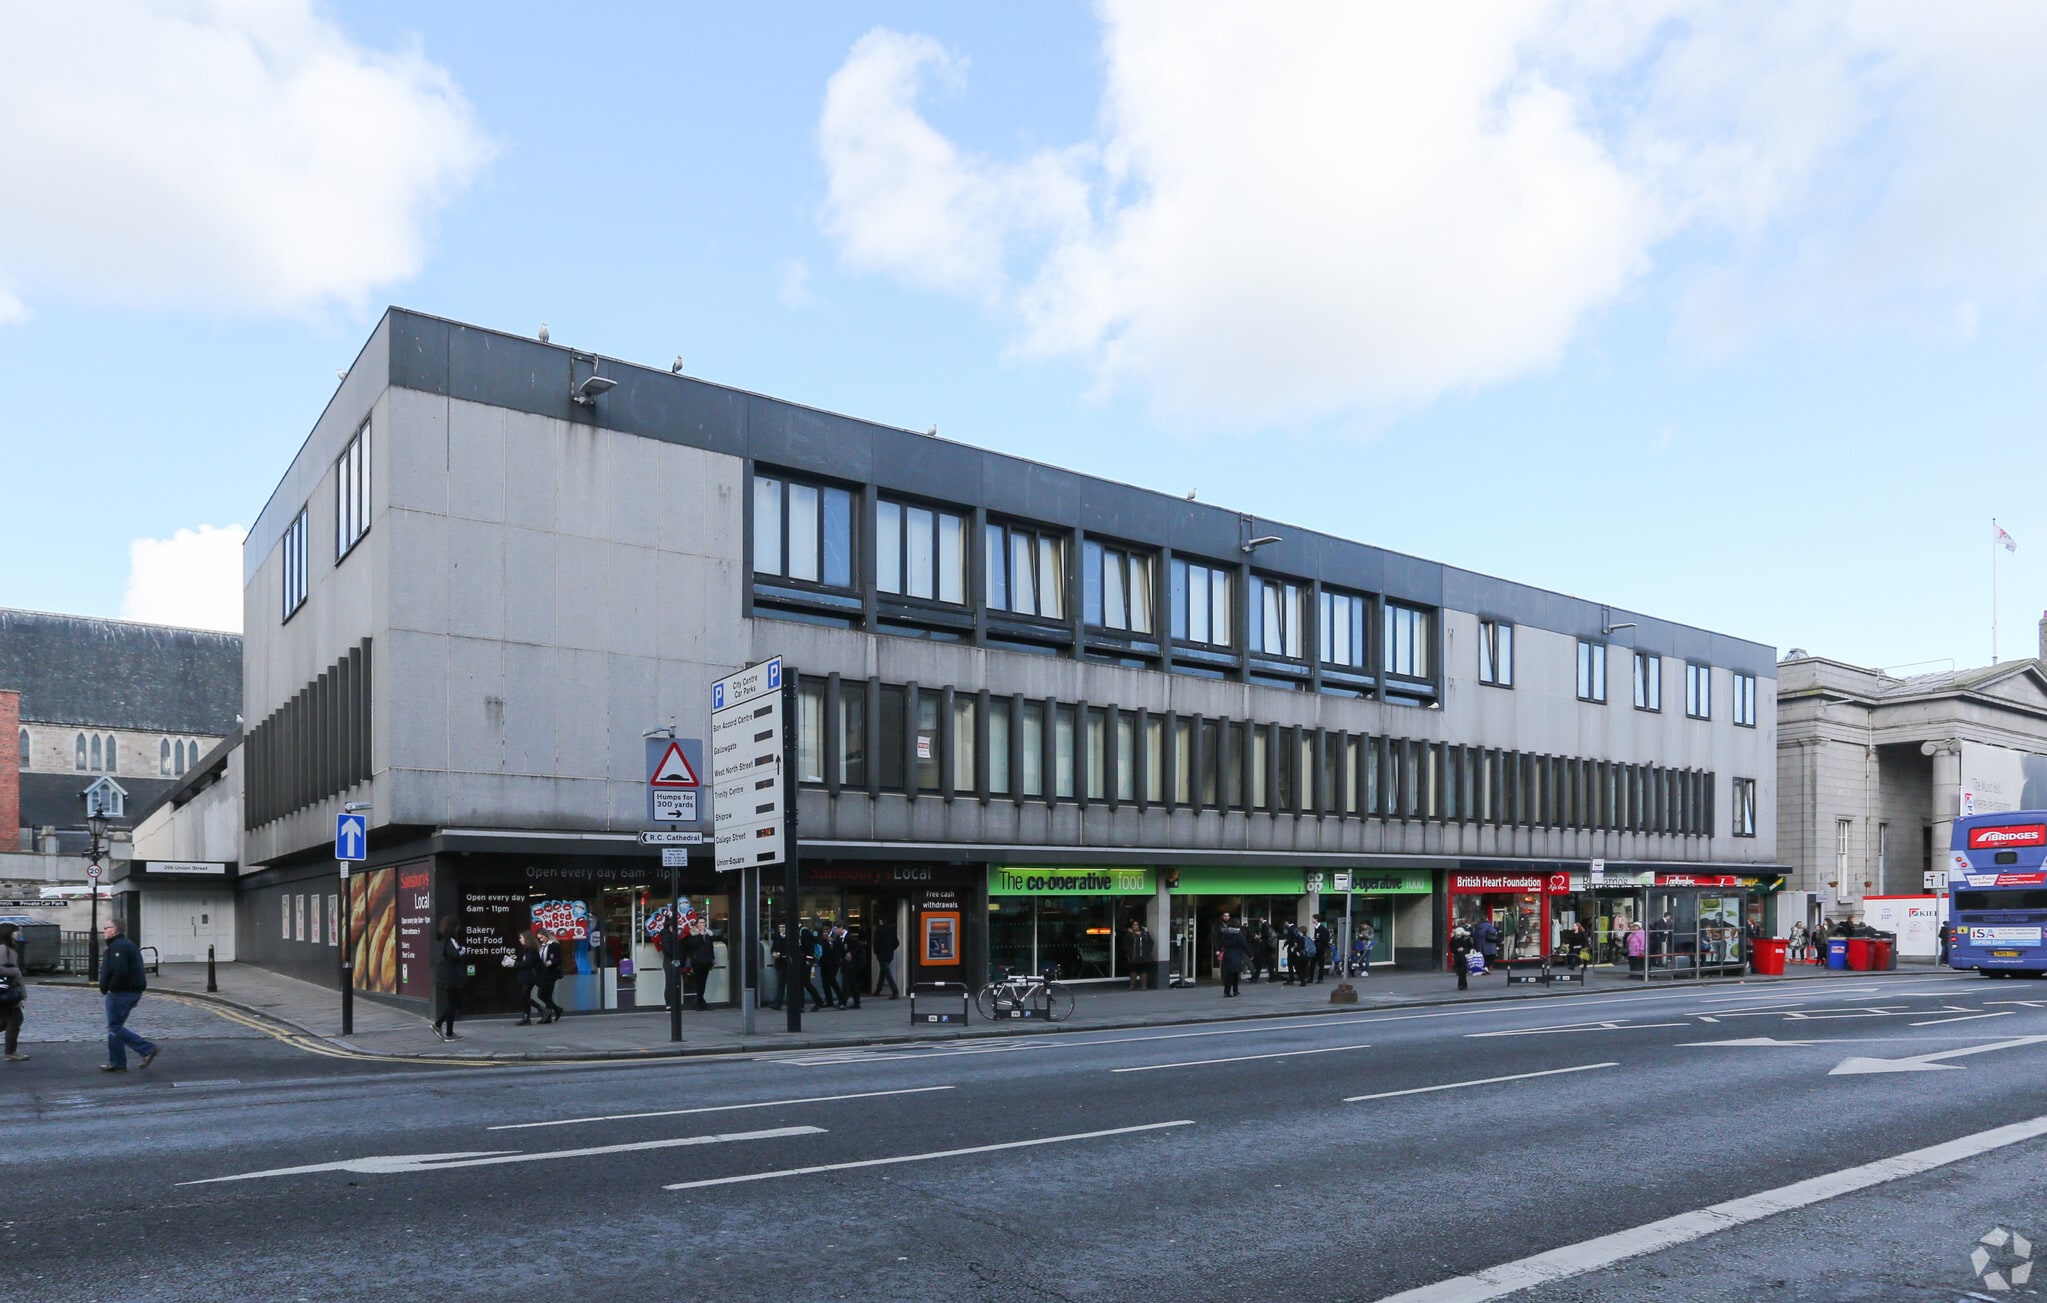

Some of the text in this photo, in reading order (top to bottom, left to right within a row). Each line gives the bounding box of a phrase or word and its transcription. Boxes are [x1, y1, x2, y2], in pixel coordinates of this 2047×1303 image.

[770, 663, 779, 687] P
[732, 674, 758, 690] City Centre
[715, 686, 723, 707] P
[744, 686, 756, 696] Parks
[713, 714, 753, 732] Bon Accord Centre
[714, 743, 737, 755] Gallowgate
[714, 761, 754, 778] West North Street
[714, 786, 744, 800] Trinity Centre
[715, 813, 732, 822] Shiprow
[716, 832, 746, 844] College Street
[716, 856, 744, 866] Union Square
[526, 866, 557, 878] Open
[560, 868, 593, 880] every
[596, 868, 617, 880] day
[620, 868, 645, 878] 6am
[893, 866, 932, 880] Local
[1000, 871, 1144, 890] The co-operative food
[1456, 876, 1481, 888] British
[1482, 876, 1501, 887] Heart
[1502, 876, 1541, 888] Foundation
[414, 892, 430, 910] Local
[466, 894, 486, 902] Open
[512, 894, 526, 902] day
[491, 905, 510, 914] 11pm
[552, 911, 572, 921] Red
[466, 926, 495, 934] Bakery
[544, 920, 574, 928] Noses
[466, 946, 516, 954] Fresh coffee
